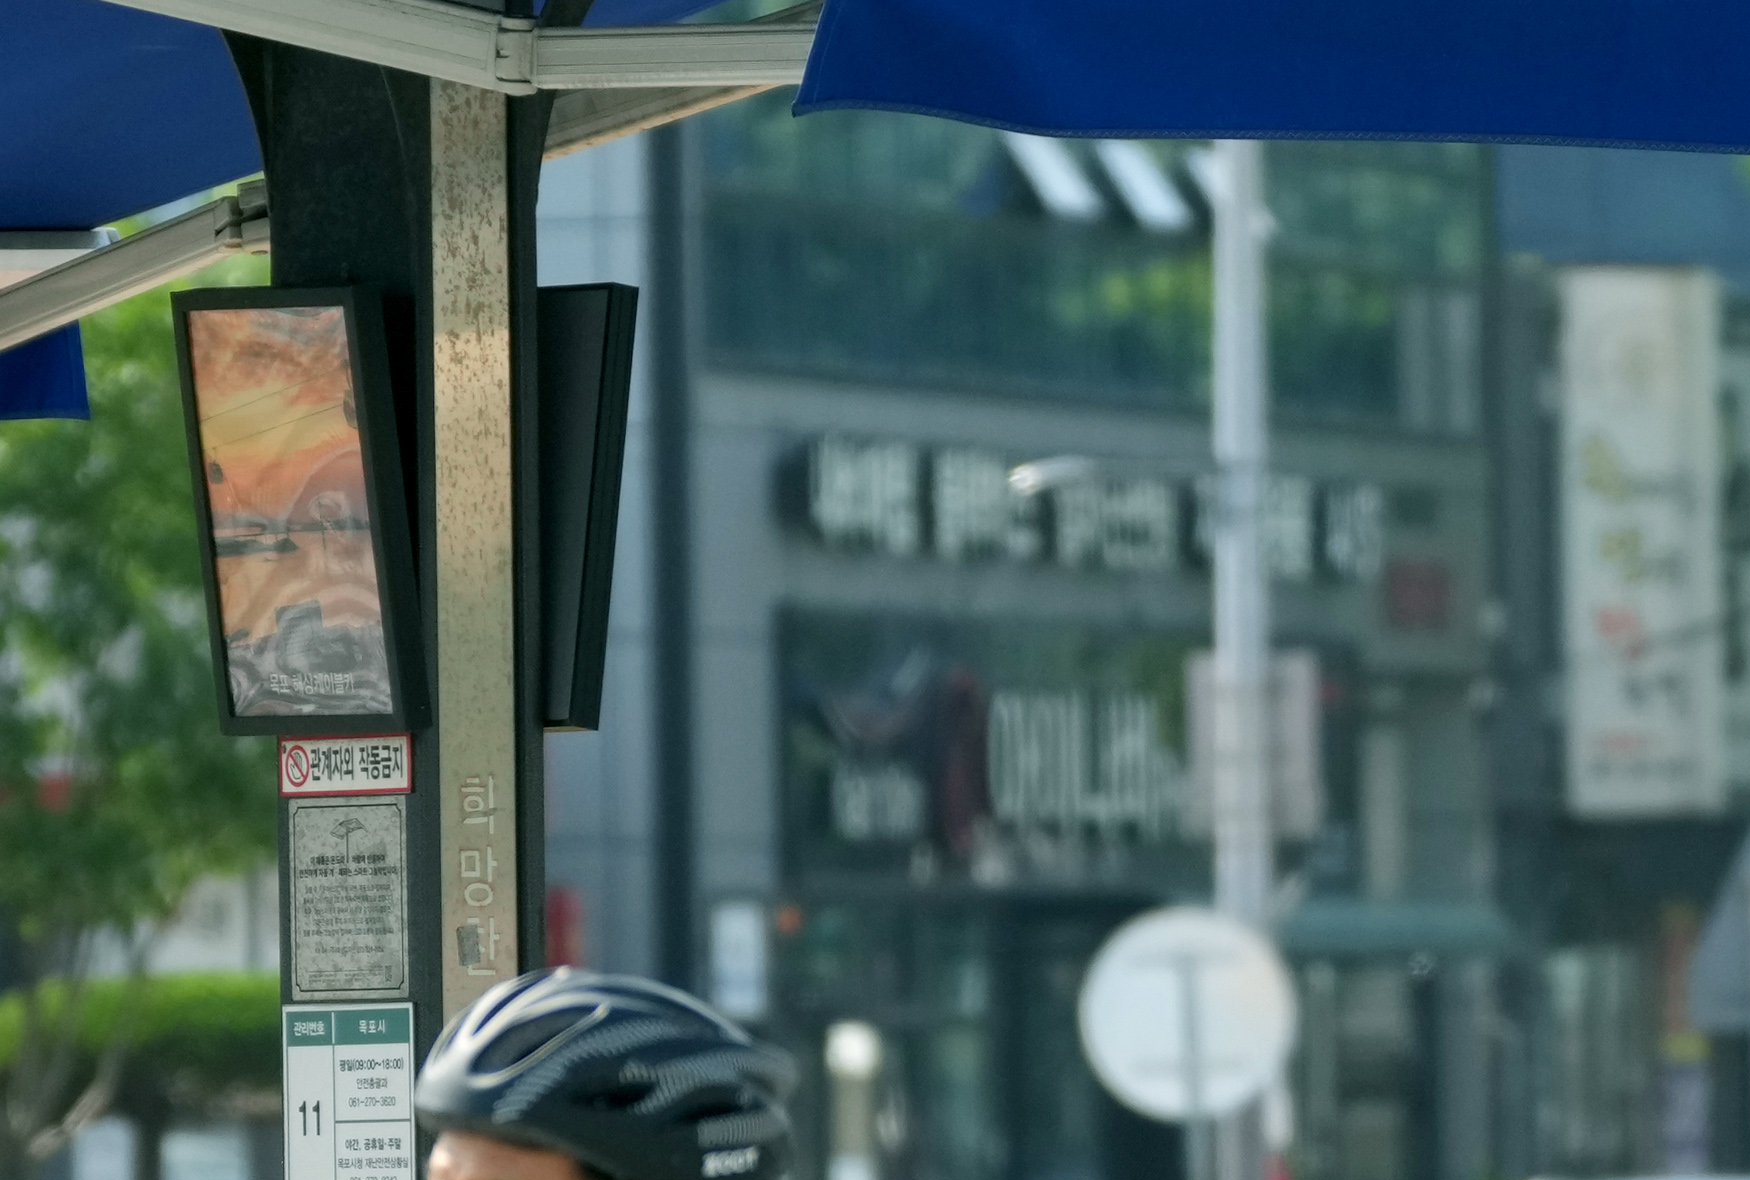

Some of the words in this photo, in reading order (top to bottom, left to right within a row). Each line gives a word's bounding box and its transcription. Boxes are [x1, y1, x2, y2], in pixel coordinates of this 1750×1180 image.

[269, 674, 290, 694] 목포
[292, 672, 355, 695] 해상케이블카
[310, 746, 354, 781] 관계자외
[359, 743, 403, 780] 작동금지
[293, 1021, 325, 1036] 관리번호
[359, 1019, 386, 1034] 목포시
[299, 1100, 321, 1136] 11
[338, 1158, 363, 1169] 목포시청
